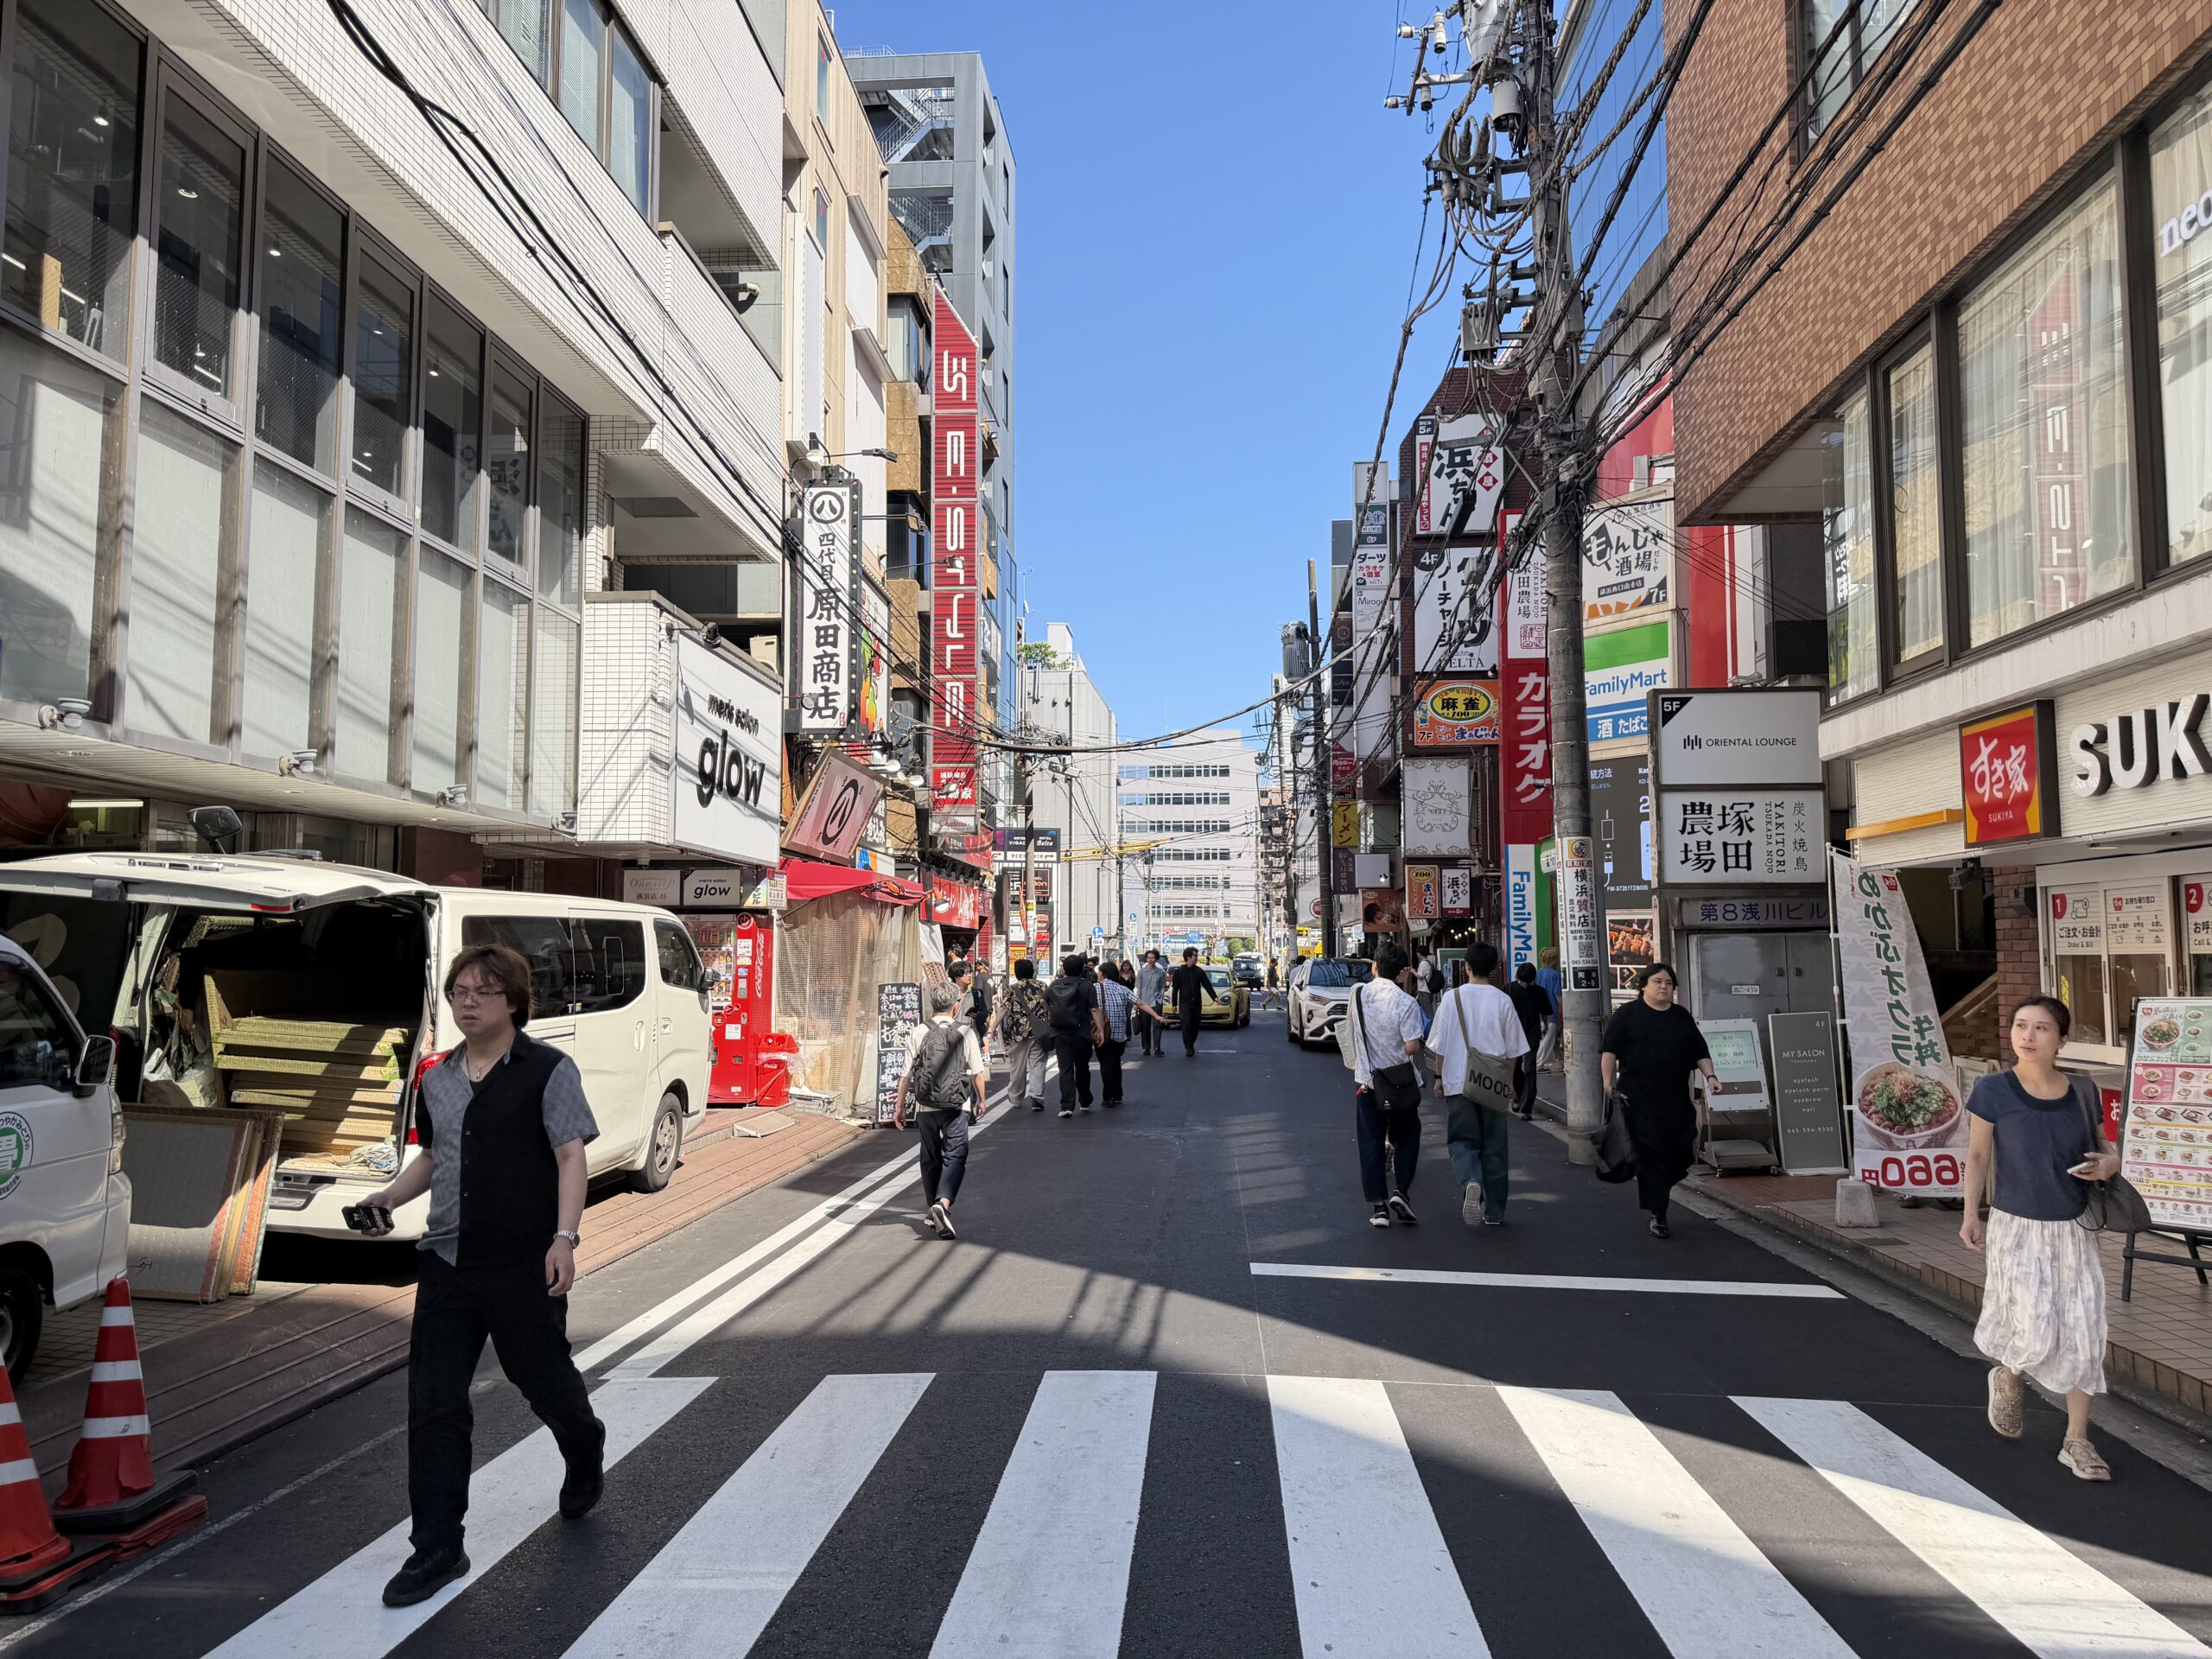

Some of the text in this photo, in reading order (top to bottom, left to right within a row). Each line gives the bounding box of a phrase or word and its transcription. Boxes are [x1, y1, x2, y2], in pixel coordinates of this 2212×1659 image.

[1357, 553, 1386, 563] ダーツ
[1421, 552, 1438, 564] 4F
[1615, 550, 1652, 577] 酒場
[1649, 588, 1666, 603] 7F
[805, 532, 841, 720] 四代目 原田商店
[1440, 697, 1479, 710] 麻雀
[1663, 702, 1681, 712] 5F
[735, 707, 760, 736] salon
[1598, 715, 1647, 739] 酒 たばこ
[1419, 732, 1432, 741] 7F
[1516, 672, 1553, 804] カラオケ
[1706, 737, 1797, 747] ORIENTAL LOUNGE
[2069, 694, 2212, 798] SUK
[696, 731, 766, 808] glow
[1970, 735, 2029, 804] すき家
[940, 817, 969, 828] Chateau
[1339, 802, 1352, 845] ラーメン
[1988, 812, 2013, 823] SUKIYA
[1775, 801, 1786, 874] YAKITORI
[1792, 802, 1808, 872] 炭火焼鳥
[694, 886, 730, 899] glow
[1574, 868, 1589, 927] 横浜質店
[2189, 888, 2197, 904] 2
[1700, 903, 1827, 923] 第8浅川ビル
[2055, 899, 2061, 912] 1
[1511, 871, 1532, 967] FamilyMa
[2193, 921, 2212, 933] お呼
